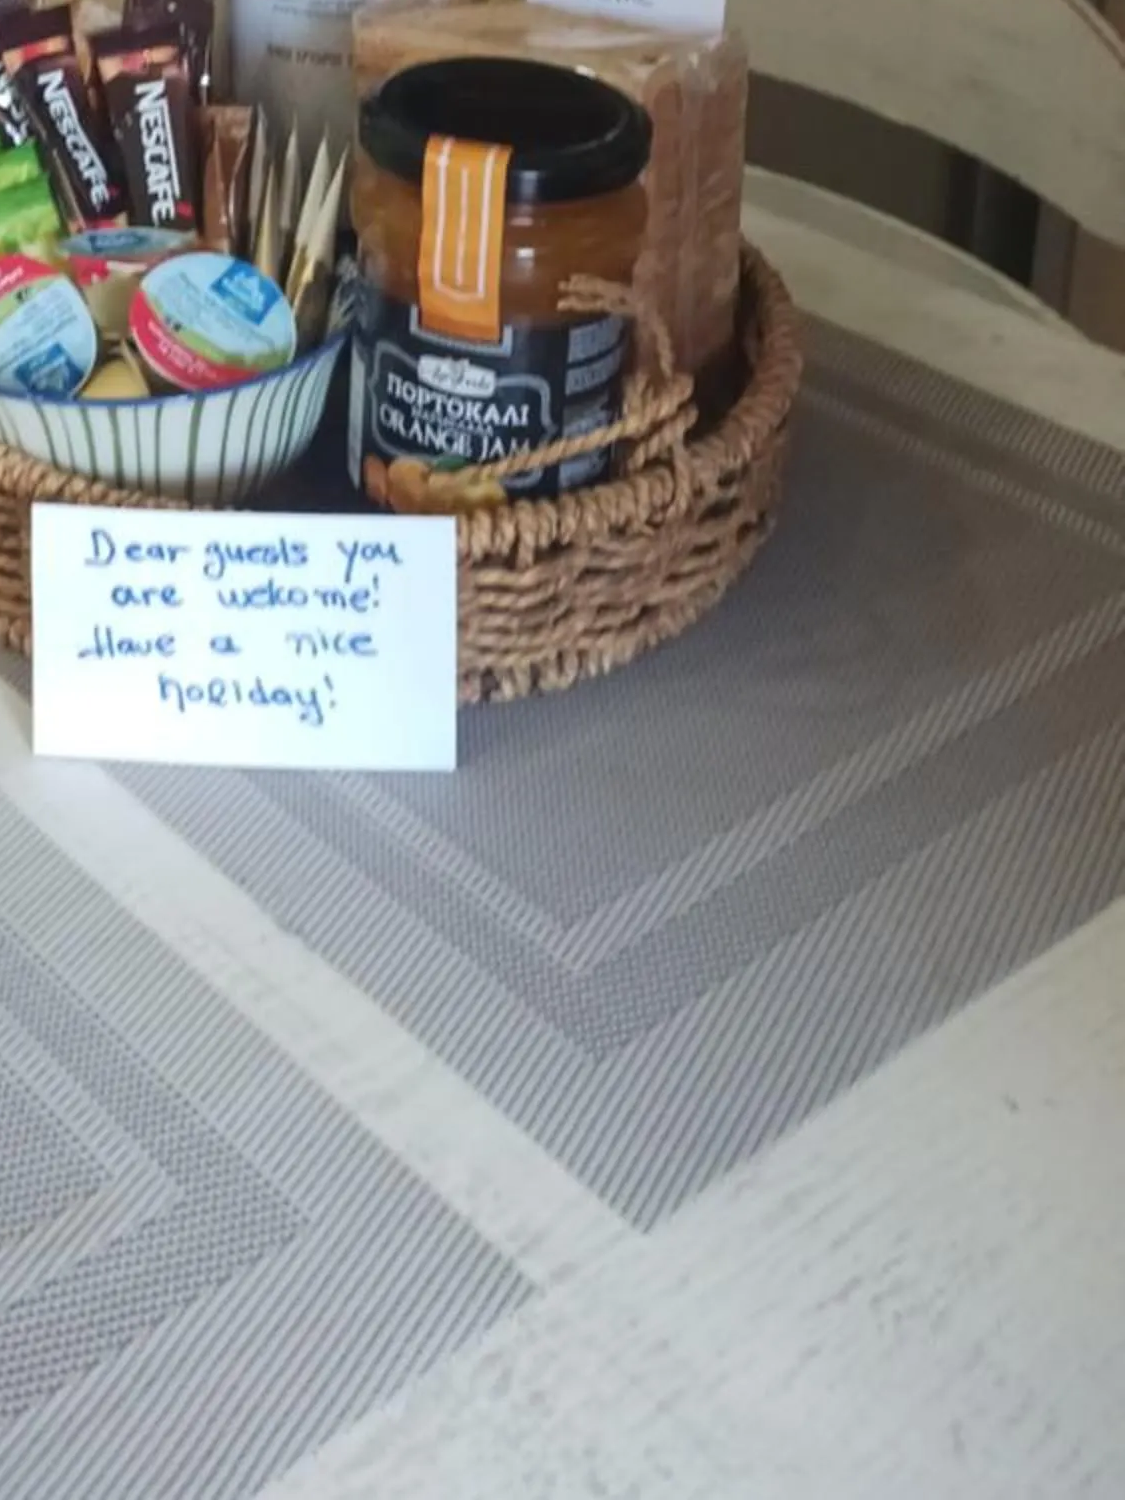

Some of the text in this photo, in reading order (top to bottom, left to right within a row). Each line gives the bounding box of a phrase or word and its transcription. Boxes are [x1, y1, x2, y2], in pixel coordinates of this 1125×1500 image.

[386, 370, 530, 427] ΠΟΡΤΟΚΑΛΙ
[379, 402, 473, 457] ORANGE
[85, 527, 403, 583] Dear guests you
[110, 581, 184, 609] are
[77, 623, 378, 660] Have a nice
[157, 671, 337, 727] holiday!
